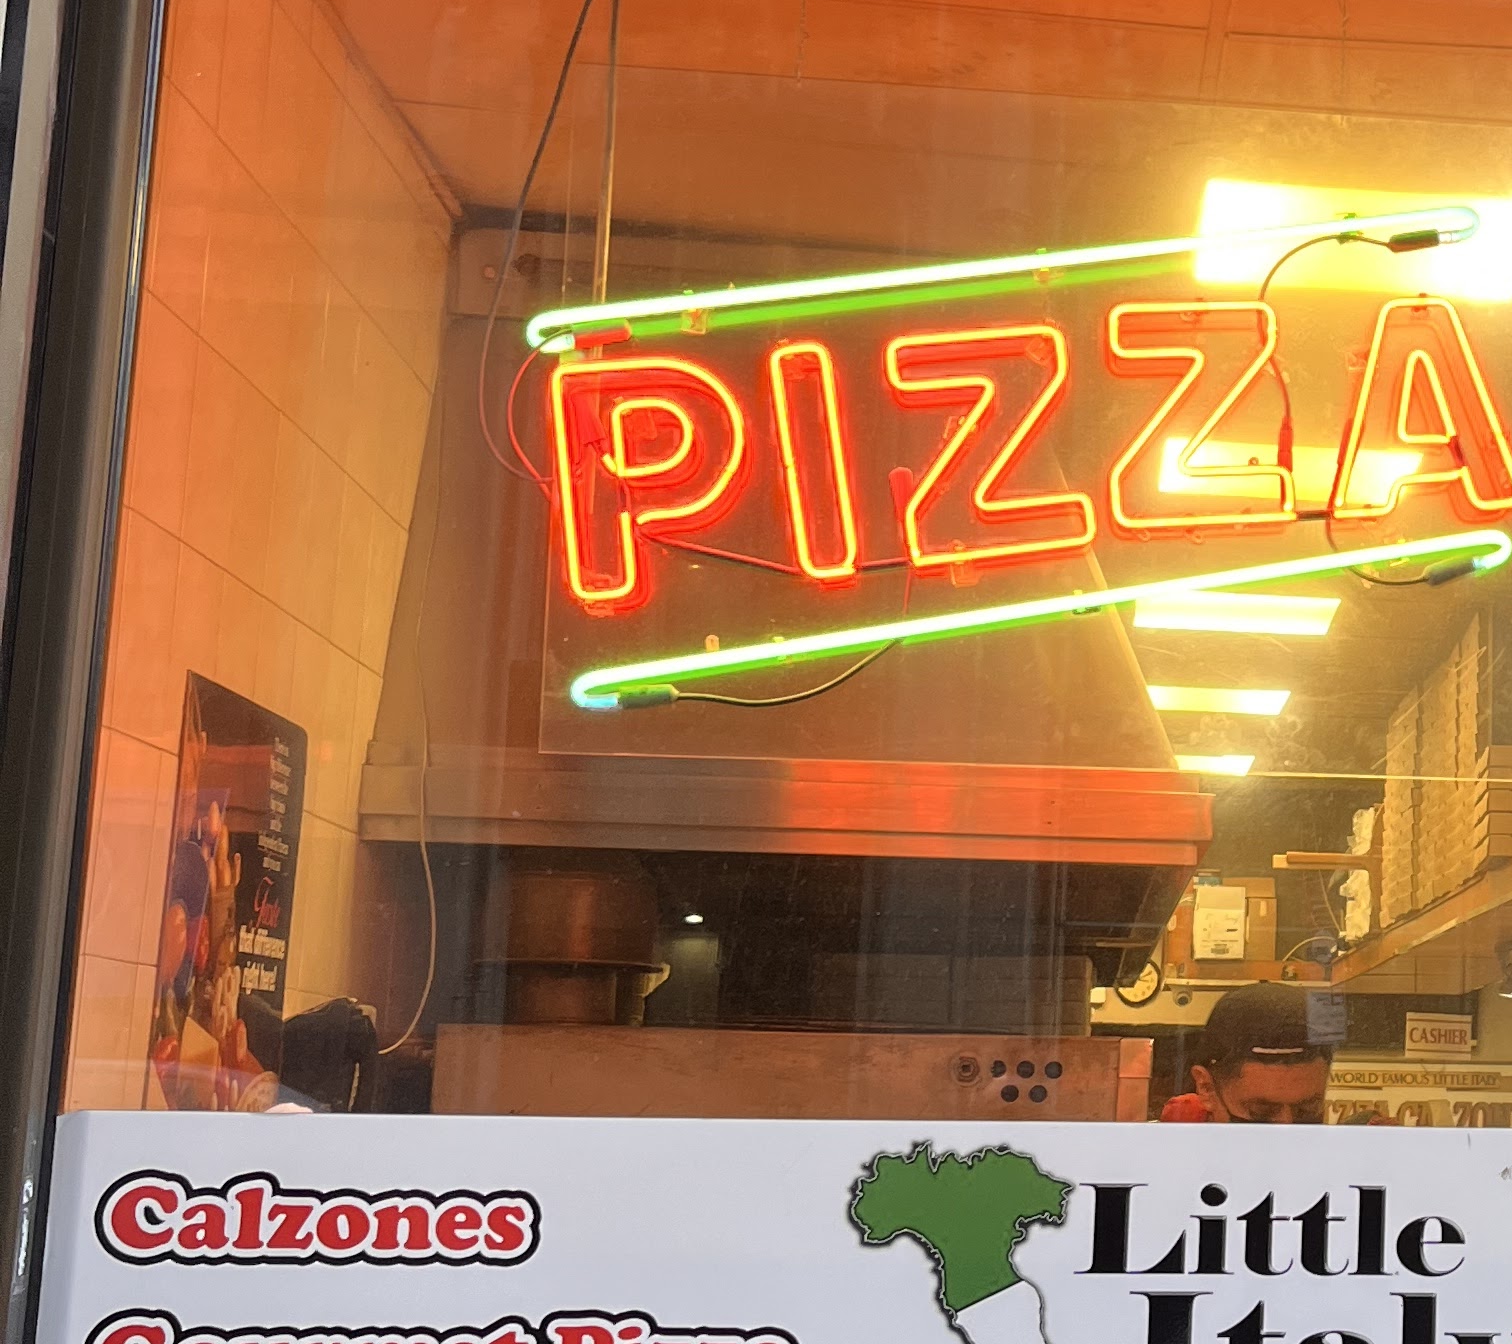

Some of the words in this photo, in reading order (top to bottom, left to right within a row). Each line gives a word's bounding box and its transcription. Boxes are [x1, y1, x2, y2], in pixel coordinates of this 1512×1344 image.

[1409, 1027, 1468, 1046] CASHIER
[1330, 1072, 1378, 1085] WORLD
[1381, 1073, 1429, 1086] FAMOUS
[1433, 1074, 1468, 1086] LITTLE
[1471, 1075, 1500, 1087] ITALY
[104, 1178, 537, 1258] Calzones
[1074, 1181, 1465, 1278] Little
